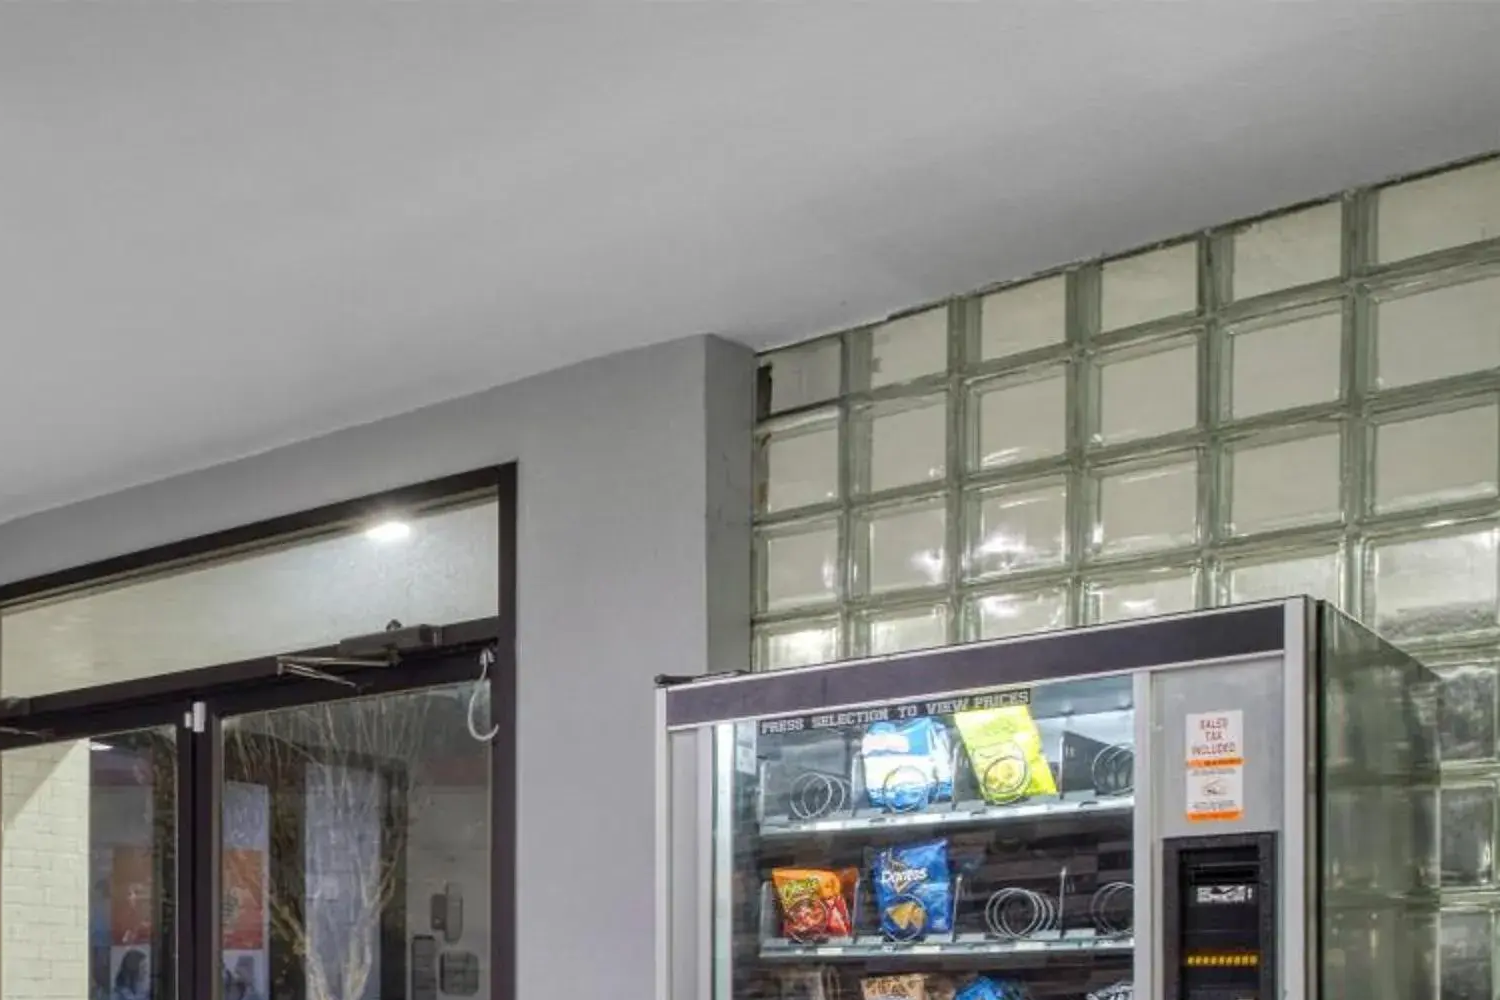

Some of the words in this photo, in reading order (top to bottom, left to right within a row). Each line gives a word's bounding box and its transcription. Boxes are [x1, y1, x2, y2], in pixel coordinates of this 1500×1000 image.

[760, 717, 804, 735] PRESS
[812, 706, 889, 728] SELECTION
[897, 703, 917, 718] TO
[926, 698, 968, 715] VIEW
[975, 691, 1029, 710] PRICES
